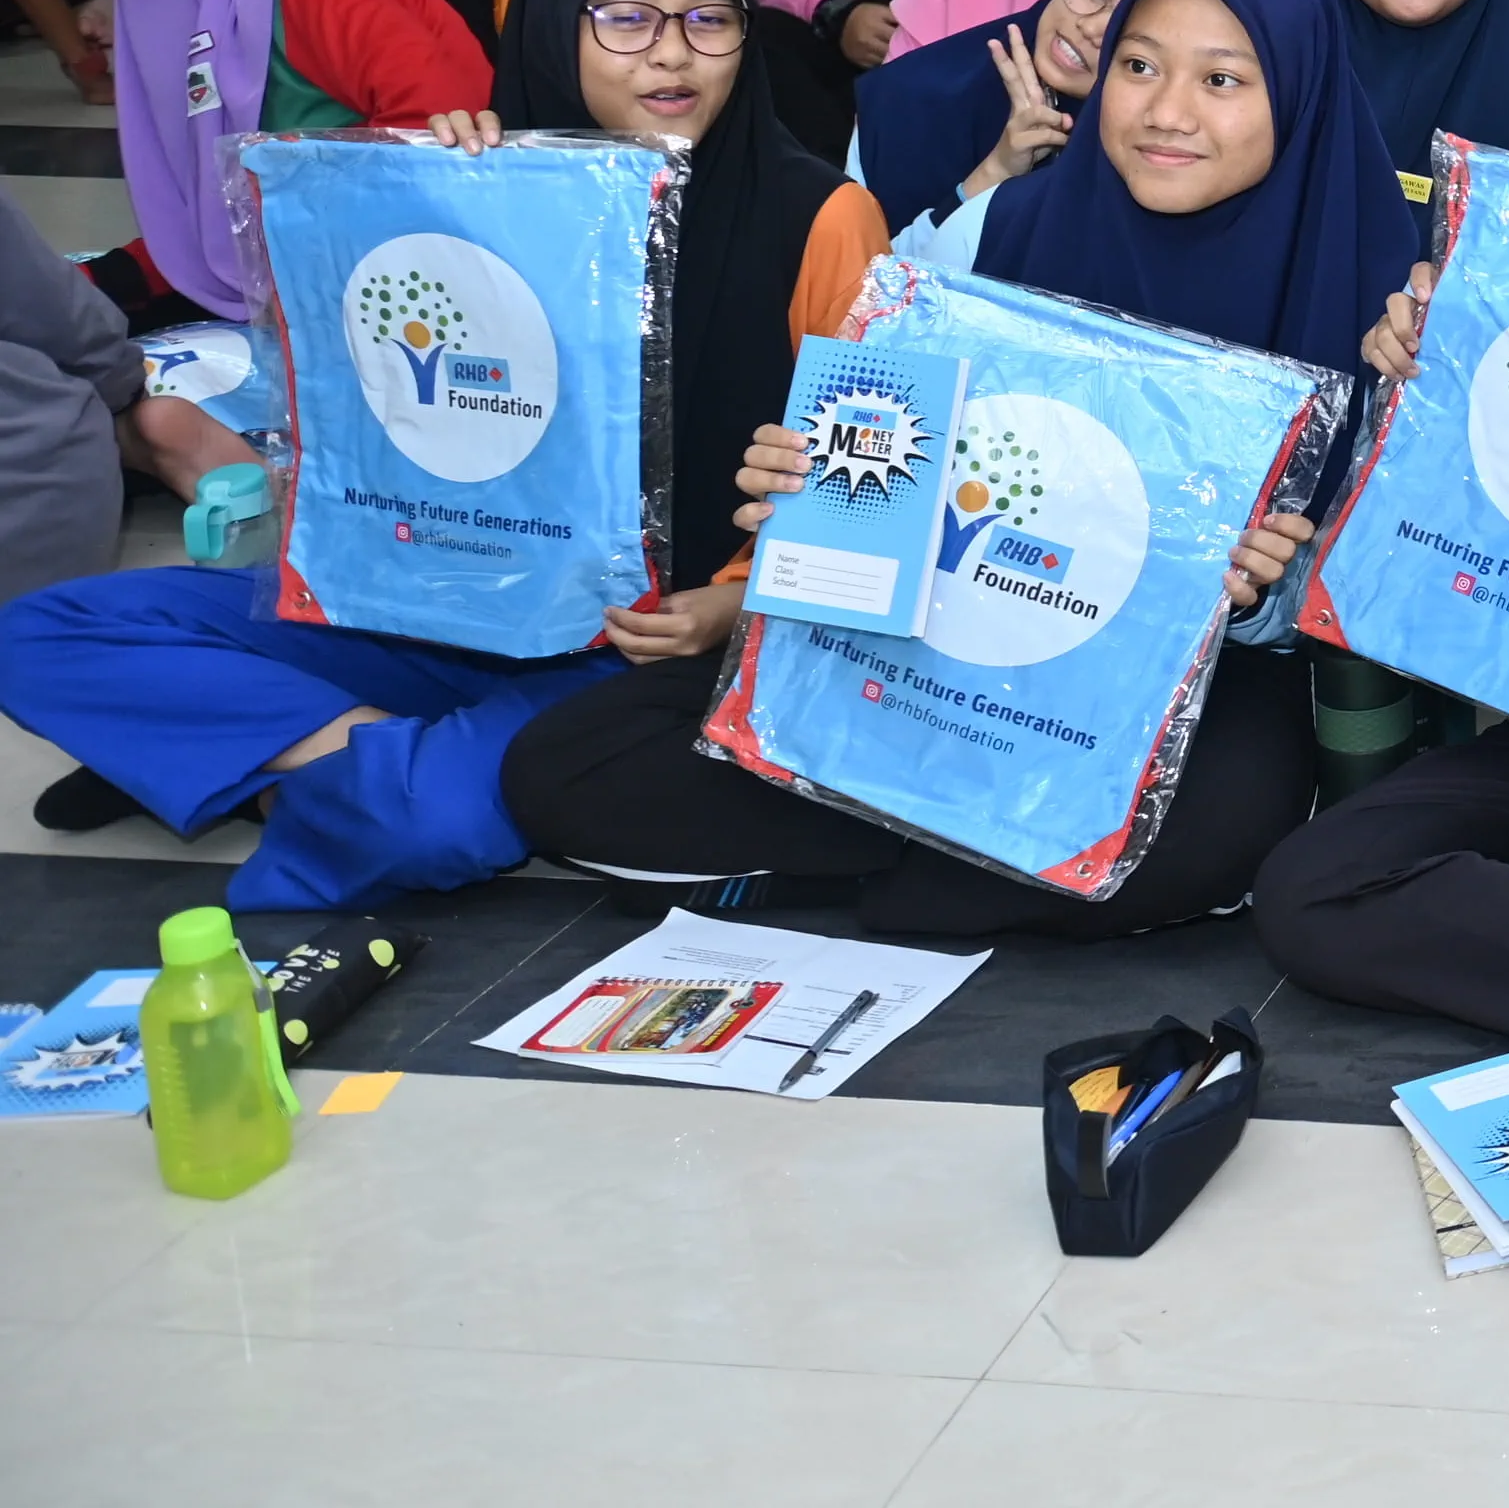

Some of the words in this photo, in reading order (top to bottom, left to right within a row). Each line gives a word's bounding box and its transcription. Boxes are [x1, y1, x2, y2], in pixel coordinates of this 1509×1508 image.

[454, 362, 488, 382] RHB
[448, 390, 542, 419] Foundation
[852, 410, 874, 423] RHB
[344, 488, 417, 520] Nurturing
[420, 501, 469, 524] Future
[474, 509, 572, 540] Generations
[411, 531, 512, 559] @rhbfoundation
[777, 553, 800, 565] Name
[995, 537, 1042, 566] RHB
[1396, 519, 1495, 576] Nurturing
[772, 576, 797, 589] School
[775, 565, 794, 576] Class
[973, 563, 1099, 620] Foundation
[808, 625, 899, 683] Nurturing
[902, 667, 966, 707] Future
[972, 693, 1098, 751] Generations
[880, 692, 1015, 755] @rhbfoundation
